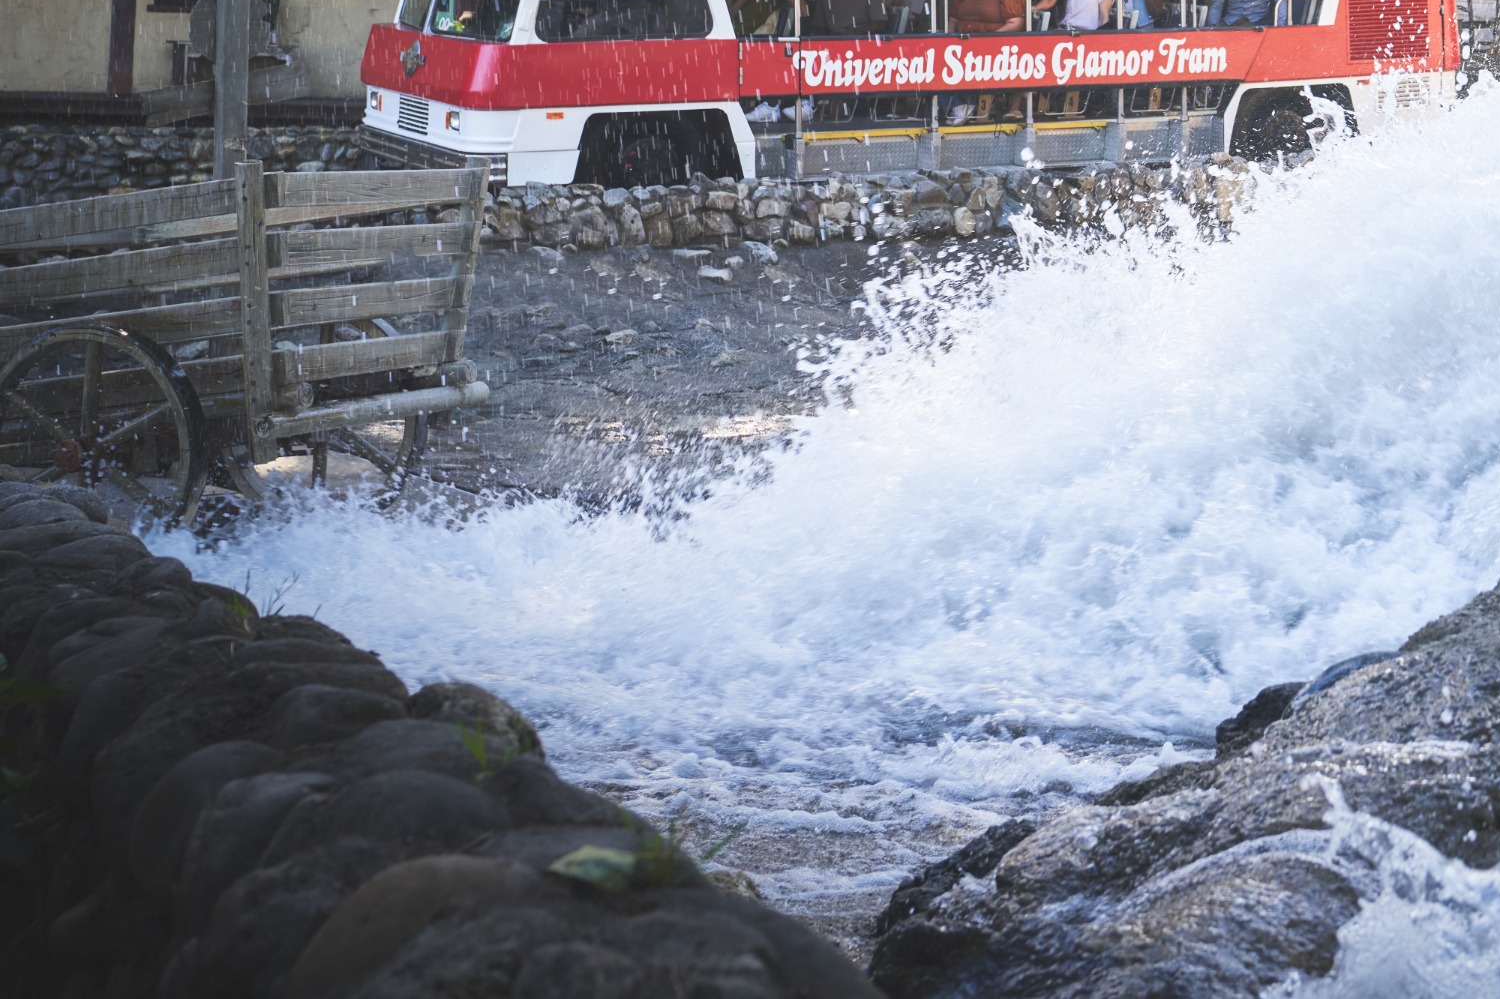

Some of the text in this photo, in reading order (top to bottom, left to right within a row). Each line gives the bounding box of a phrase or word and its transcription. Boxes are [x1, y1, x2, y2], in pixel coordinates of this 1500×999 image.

[793, 37, 1227, 87] Universal Studios Glamor Tram
